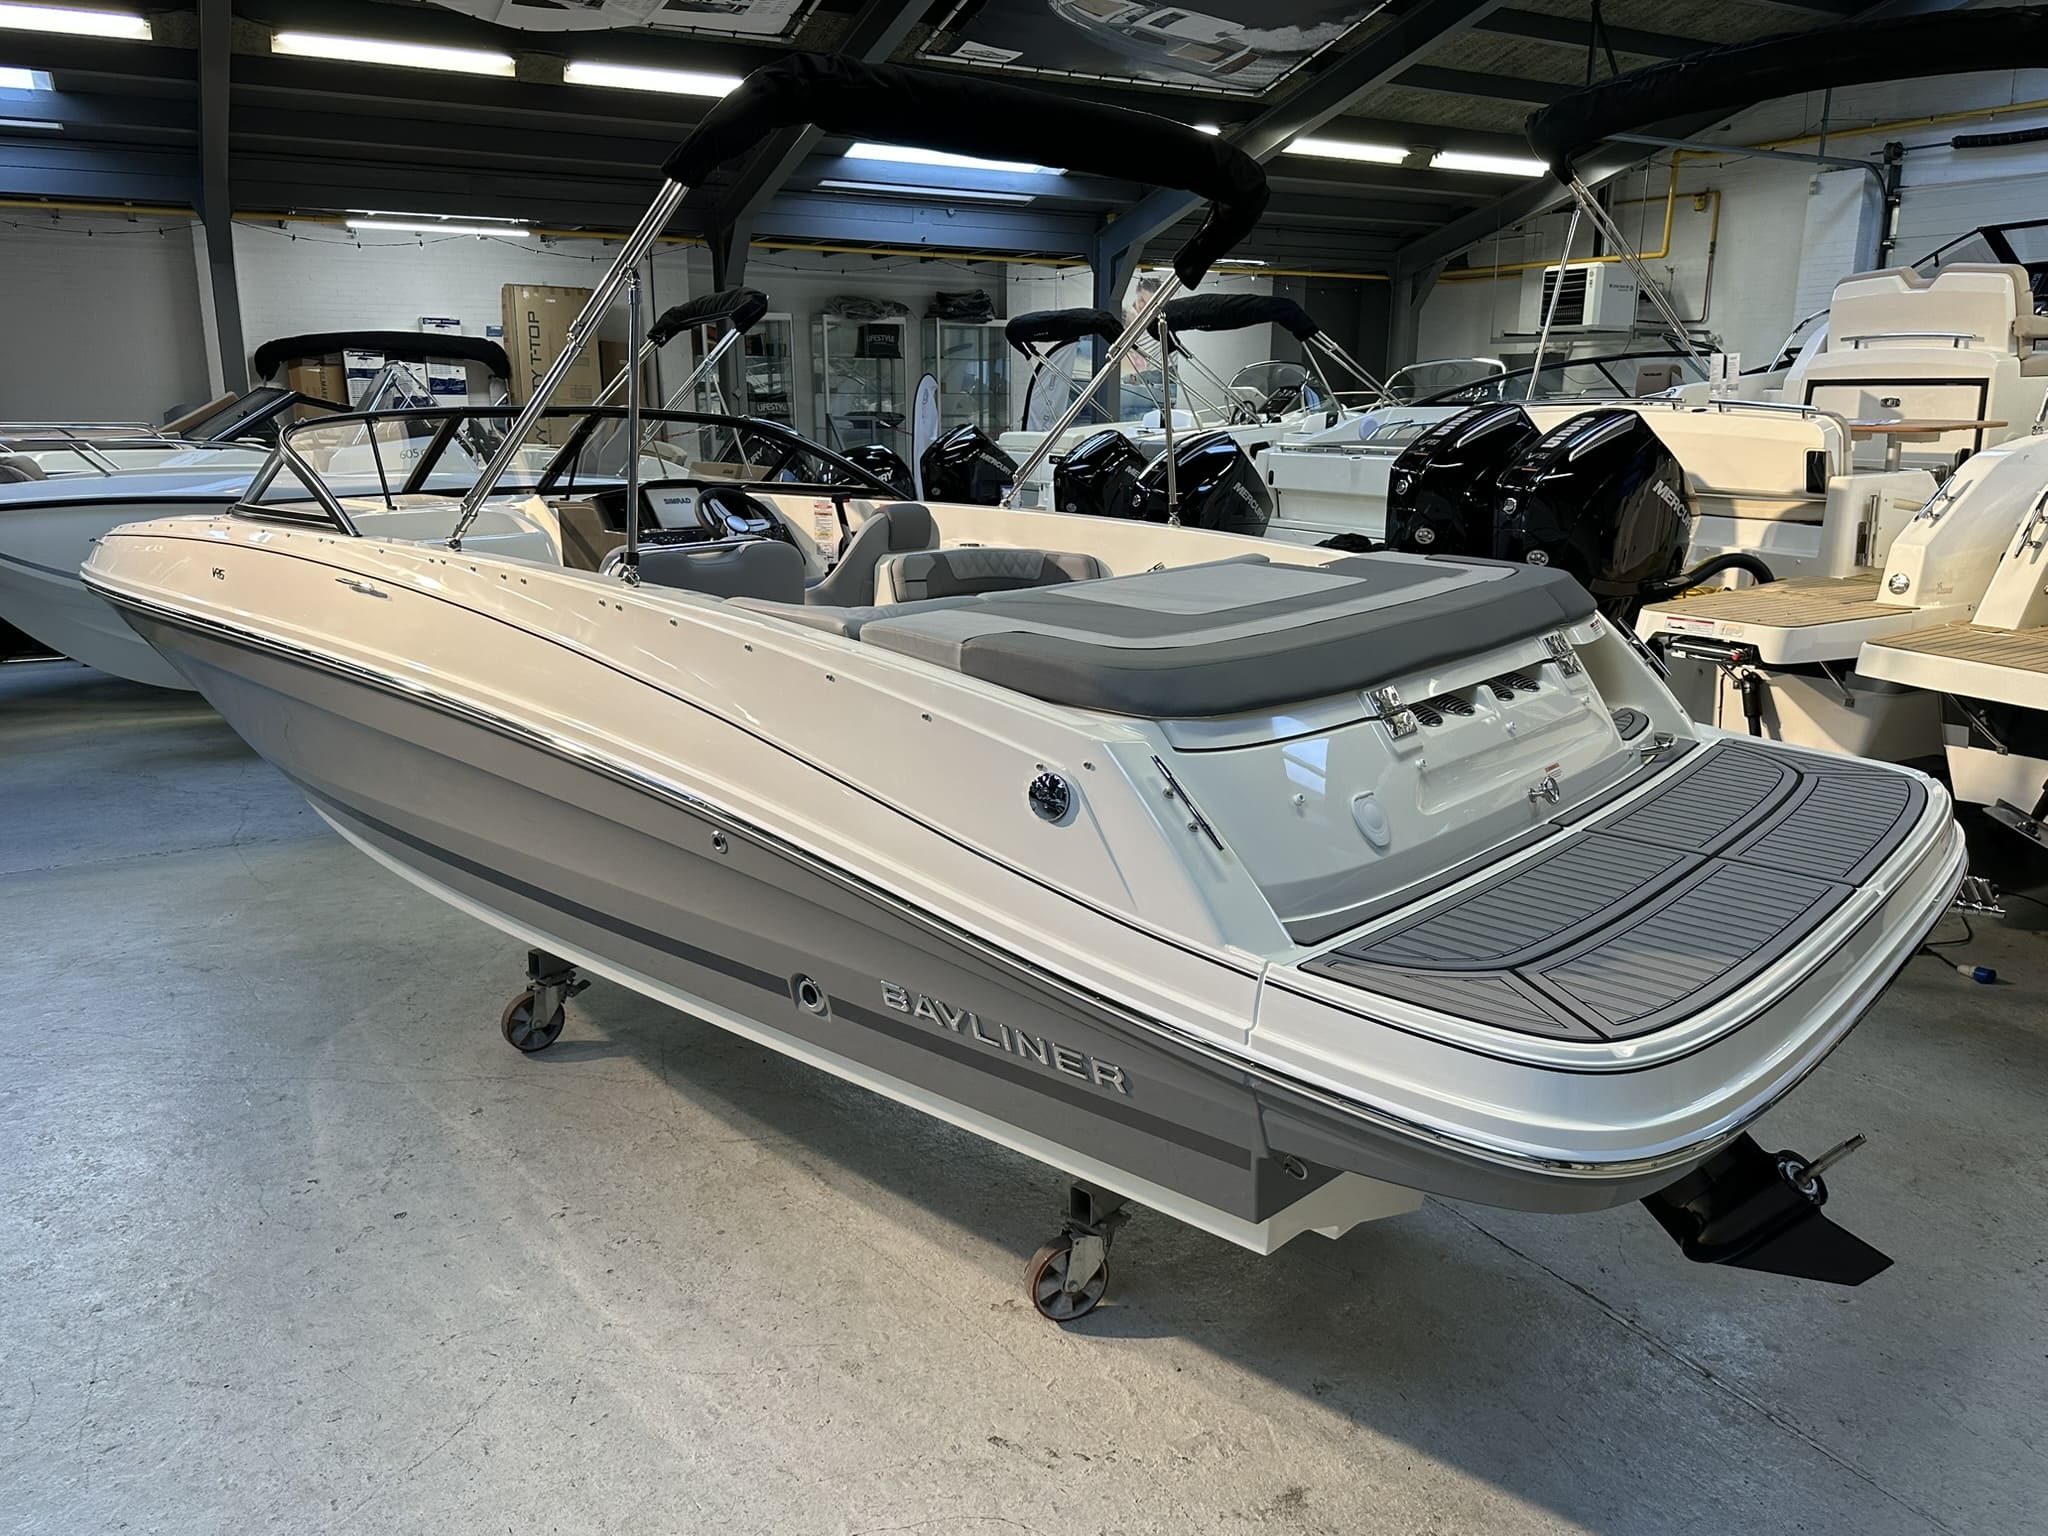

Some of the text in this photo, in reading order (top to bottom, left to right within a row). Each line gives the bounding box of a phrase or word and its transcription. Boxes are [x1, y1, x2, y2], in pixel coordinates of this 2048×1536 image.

[527, 310, 542, 366] T-TOP
[1232, 481, 1266, 523] MERCURY
[1652, 479, 1692, 531] MERCUR
[880, 979, 1129, 1095] BAYLINER
